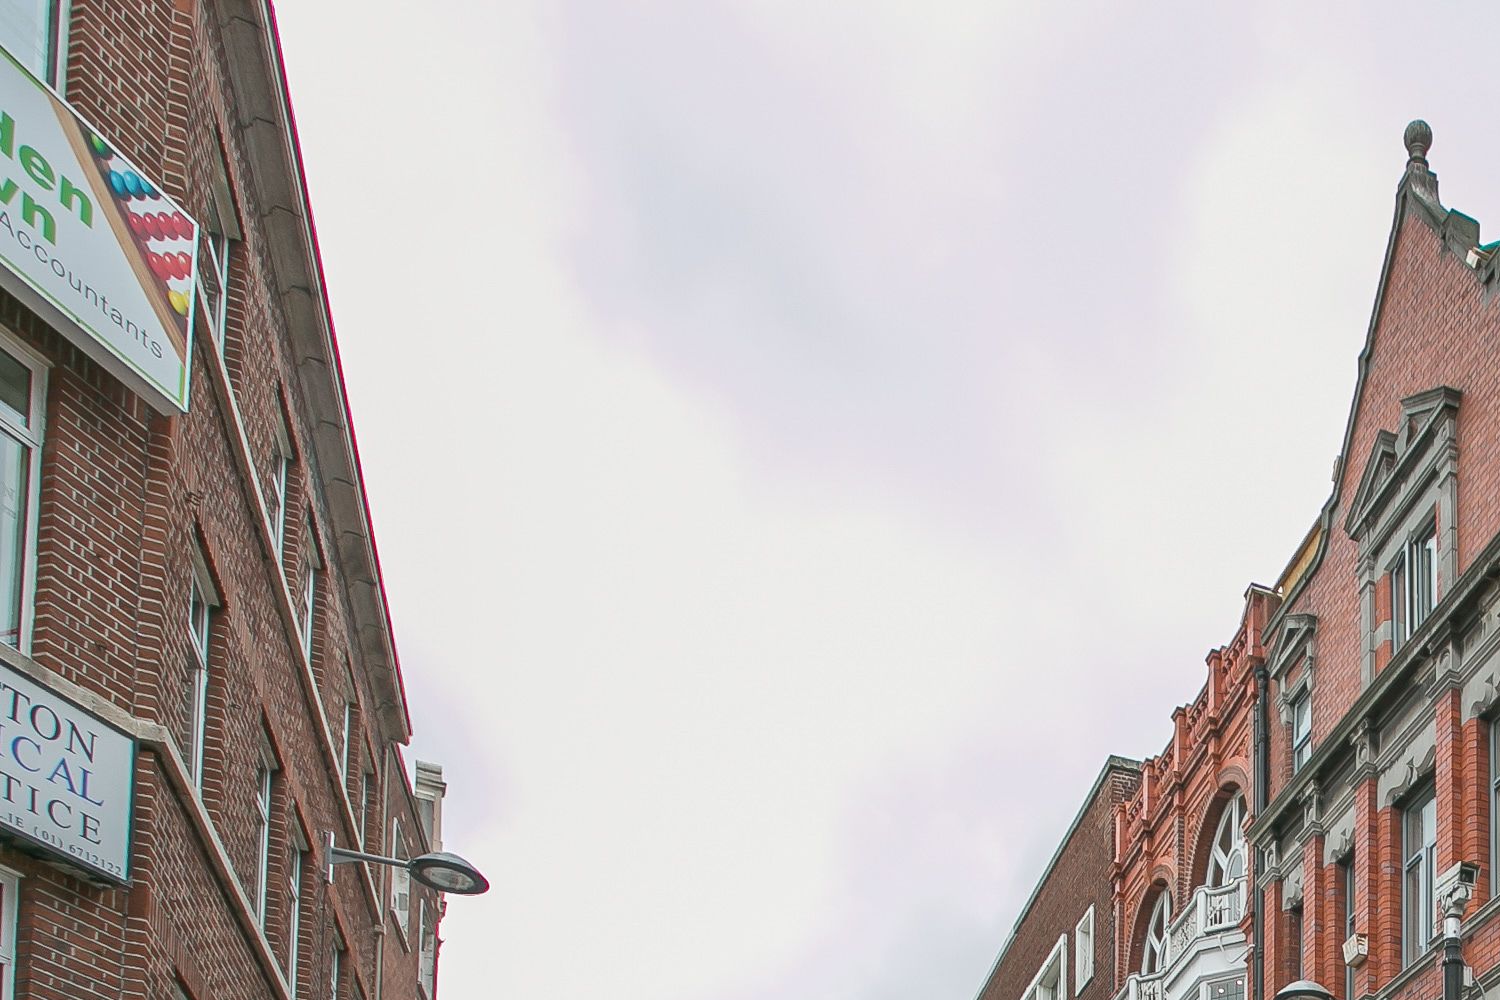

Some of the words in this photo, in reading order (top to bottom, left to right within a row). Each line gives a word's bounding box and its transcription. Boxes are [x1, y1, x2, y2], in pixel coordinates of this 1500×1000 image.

[0, 210, 163, 359] Accountants
[0, 682, 99, 764] TON
[0, 770, 102, 845] TICE
[33, 825, 64, 850] (01)
[69, 843, 122, 877] 6712122
